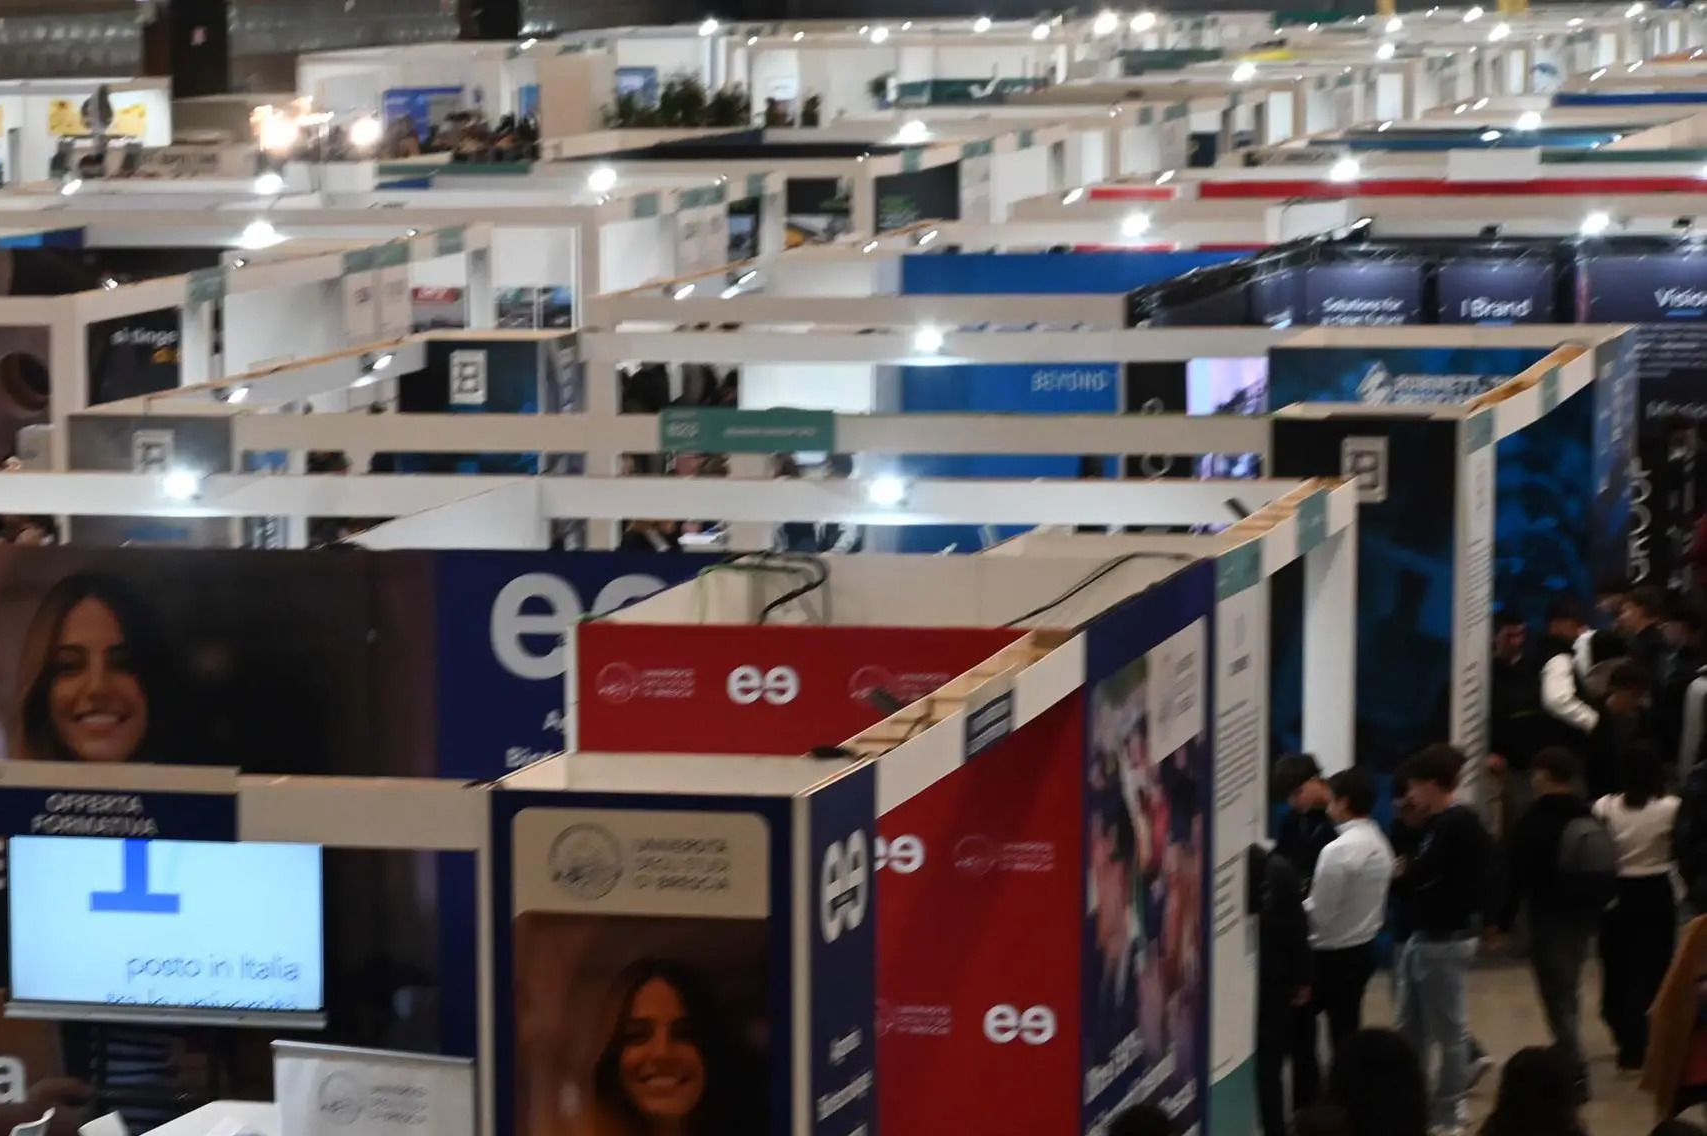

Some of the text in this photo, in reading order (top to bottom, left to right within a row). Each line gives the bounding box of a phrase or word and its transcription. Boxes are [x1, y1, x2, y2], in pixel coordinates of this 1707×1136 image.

[126, 953, 301, 985] posto in Italia
